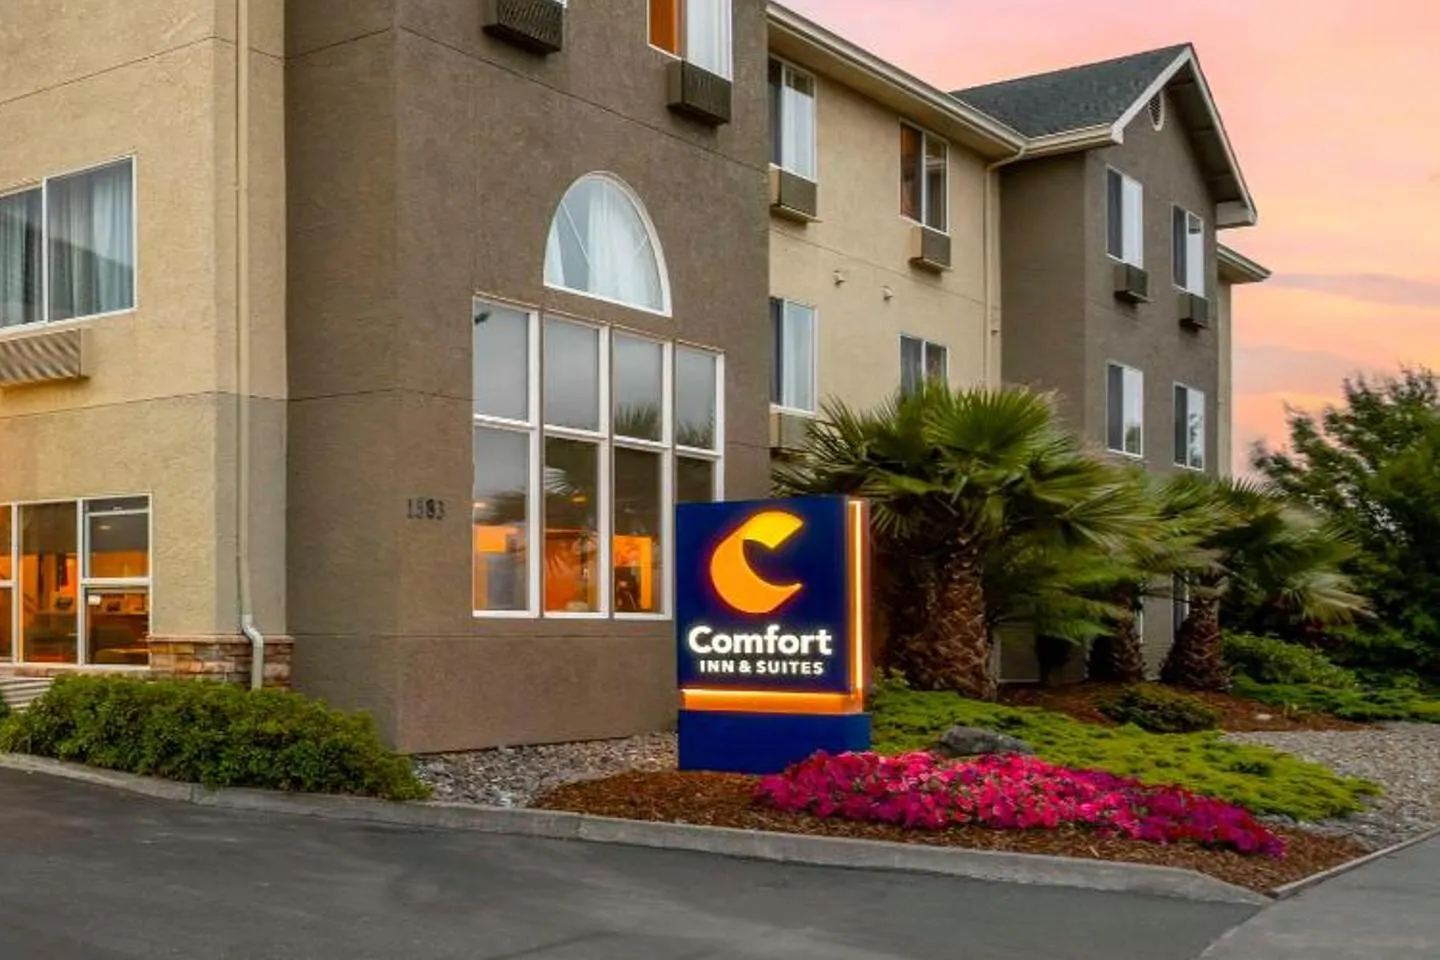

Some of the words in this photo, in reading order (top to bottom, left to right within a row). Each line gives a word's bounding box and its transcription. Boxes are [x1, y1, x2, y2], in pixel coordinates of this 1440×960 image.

[687, 623, 833, 656] Comfort
[699, 659, 734, 674] INN
[739, 659, 752, 674] &
[755, 659, 825, 676] SUITES
